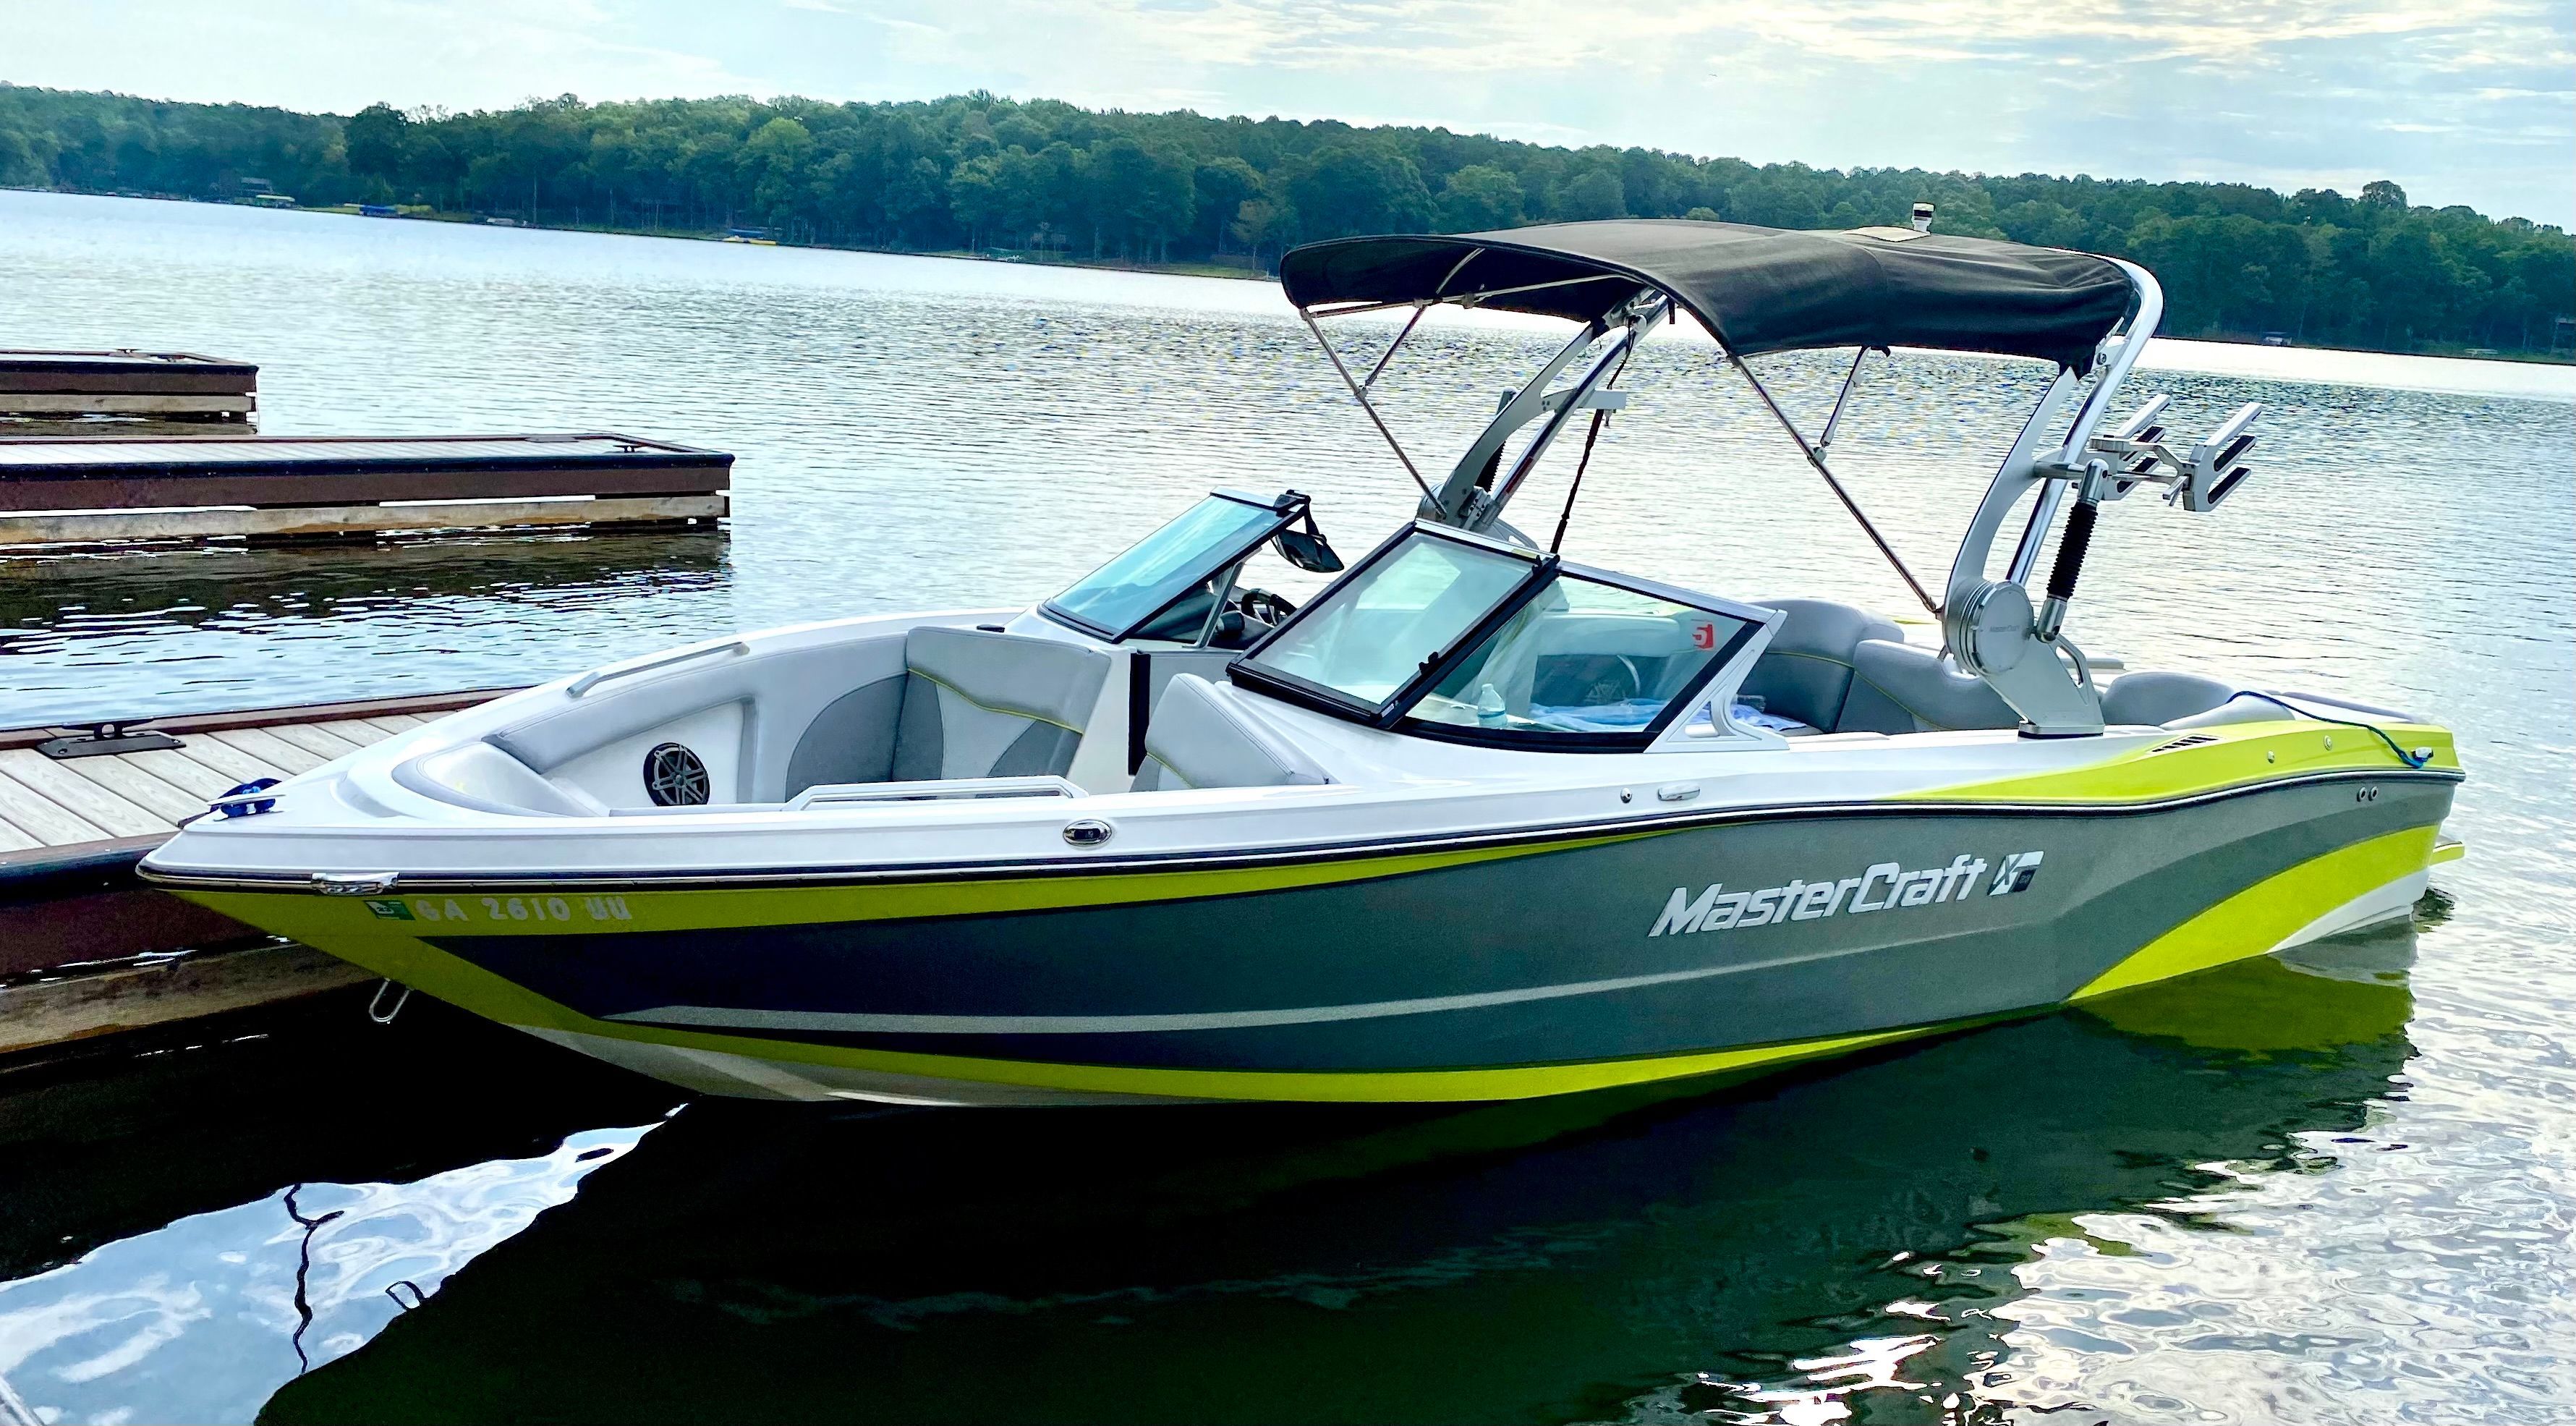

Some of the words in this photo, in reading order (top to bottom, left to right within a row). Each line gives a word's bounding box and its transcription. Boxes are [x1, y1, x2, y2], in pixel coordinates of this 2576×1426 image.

[415, 899, 469, 921] GA
[481, 897, 571, 921] 2610
[1648, 854, 1988, 937] MasterCraft
